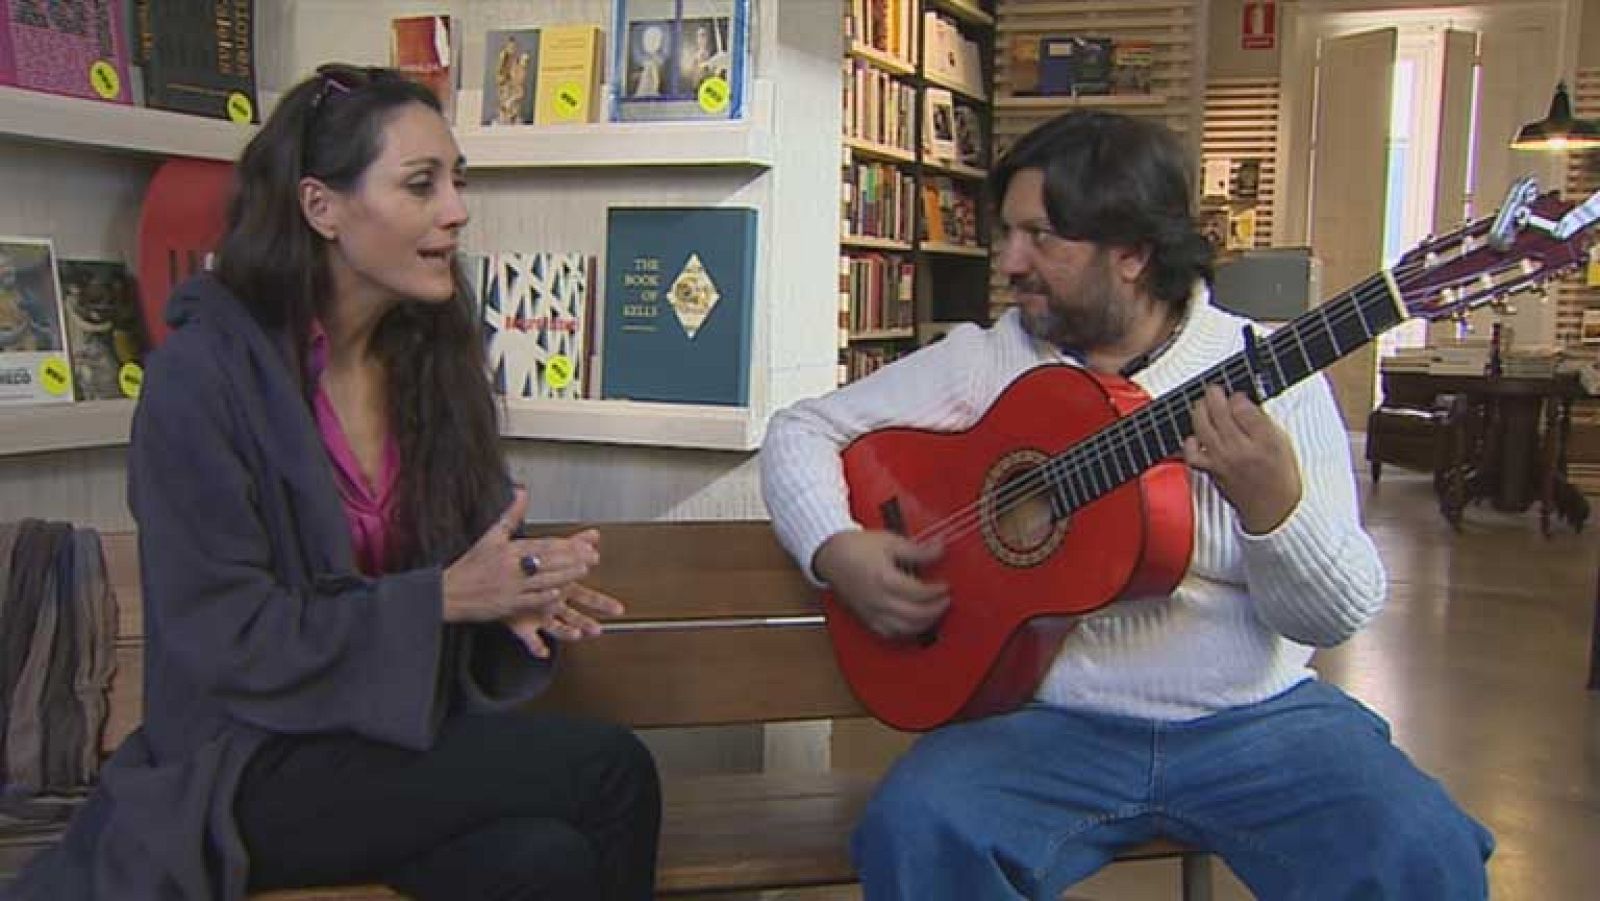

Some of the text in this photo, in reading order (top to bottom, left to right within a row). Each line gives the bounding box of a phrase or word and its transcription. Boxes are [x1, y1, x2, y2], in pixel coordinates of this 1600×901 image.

[633, 258, 659, 271] THE
[624, 274, 660, 287] BOOK
[641, 291, 658, 303] OF
[623, 305, 658, 318] KELLS
